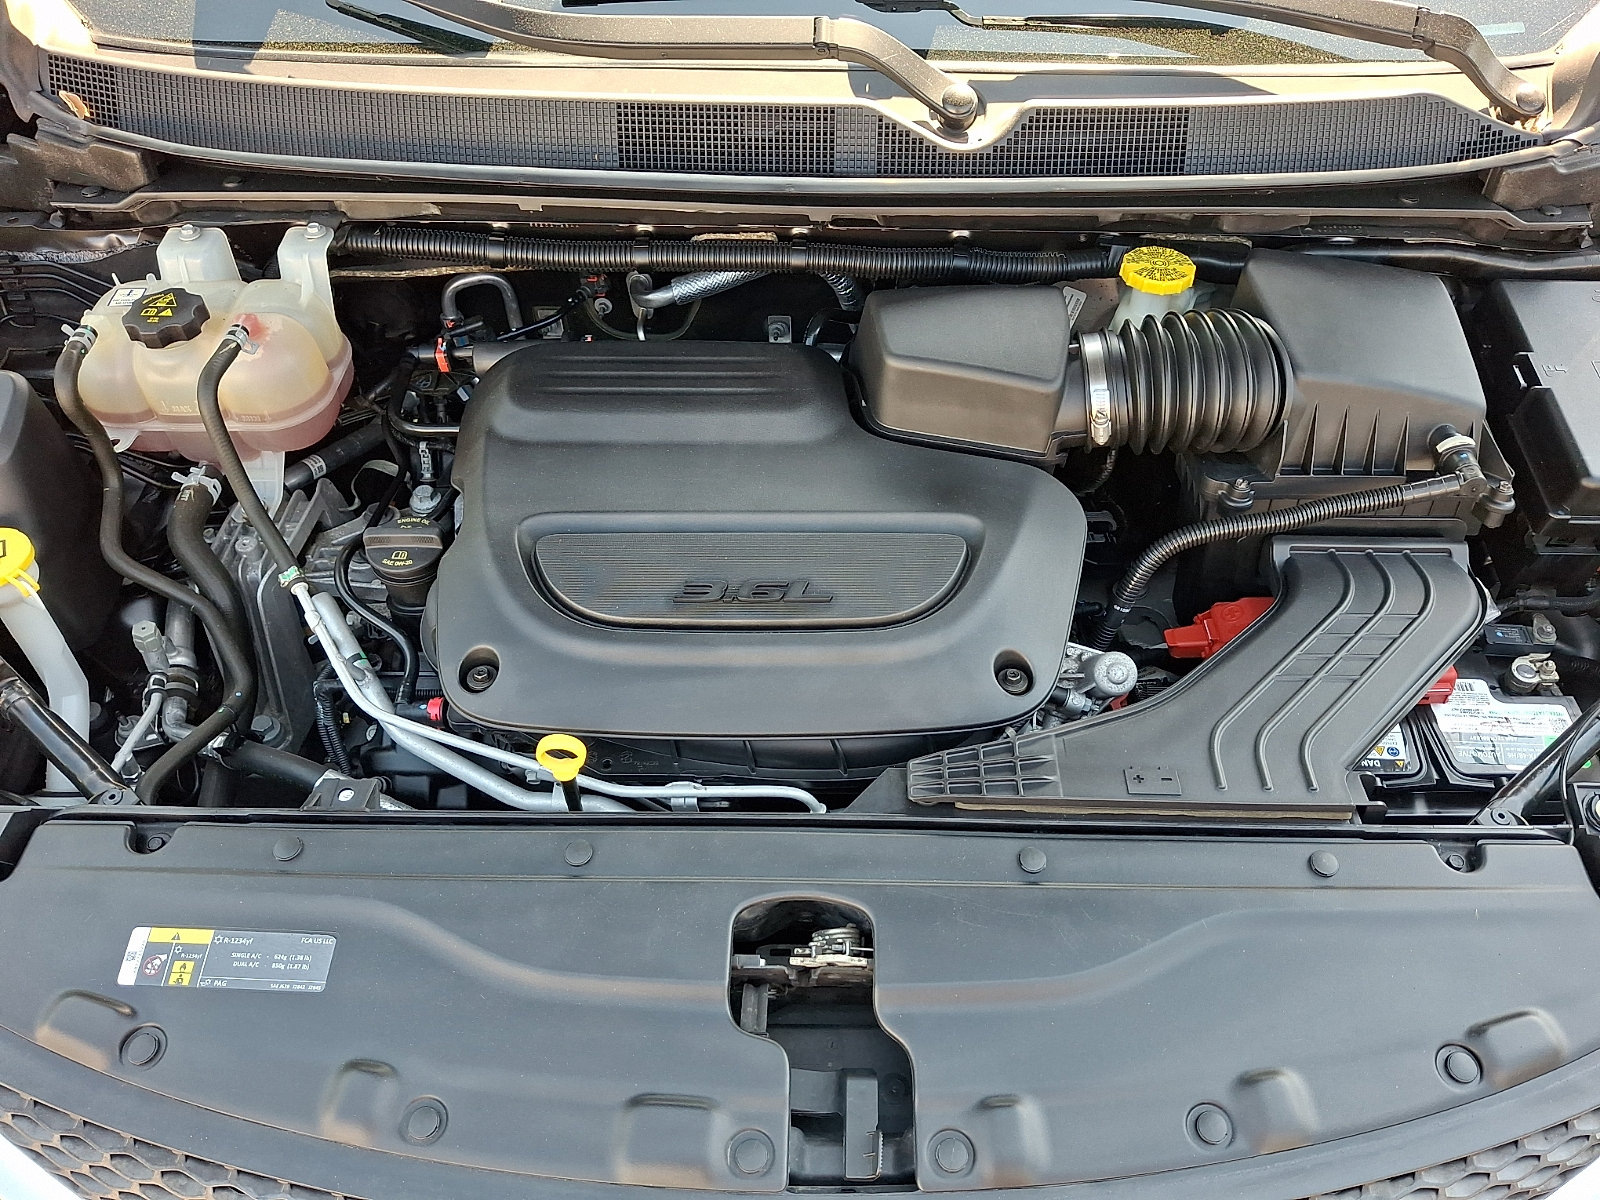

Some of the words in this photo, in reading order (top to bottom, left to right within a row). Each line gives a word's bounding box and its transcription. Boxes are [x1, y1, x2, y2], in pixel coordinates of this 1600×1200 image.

[381, 558, 394, 566] SAE
[672, 578, 834, 604] 3.6L
[1458, 750, 1501, 759] AUTOMOTIVE
[223, 937, 254, 946] R-1234yf
[322, 937, 334, 945] LLC
[213, 979, 228, 987] PAG
